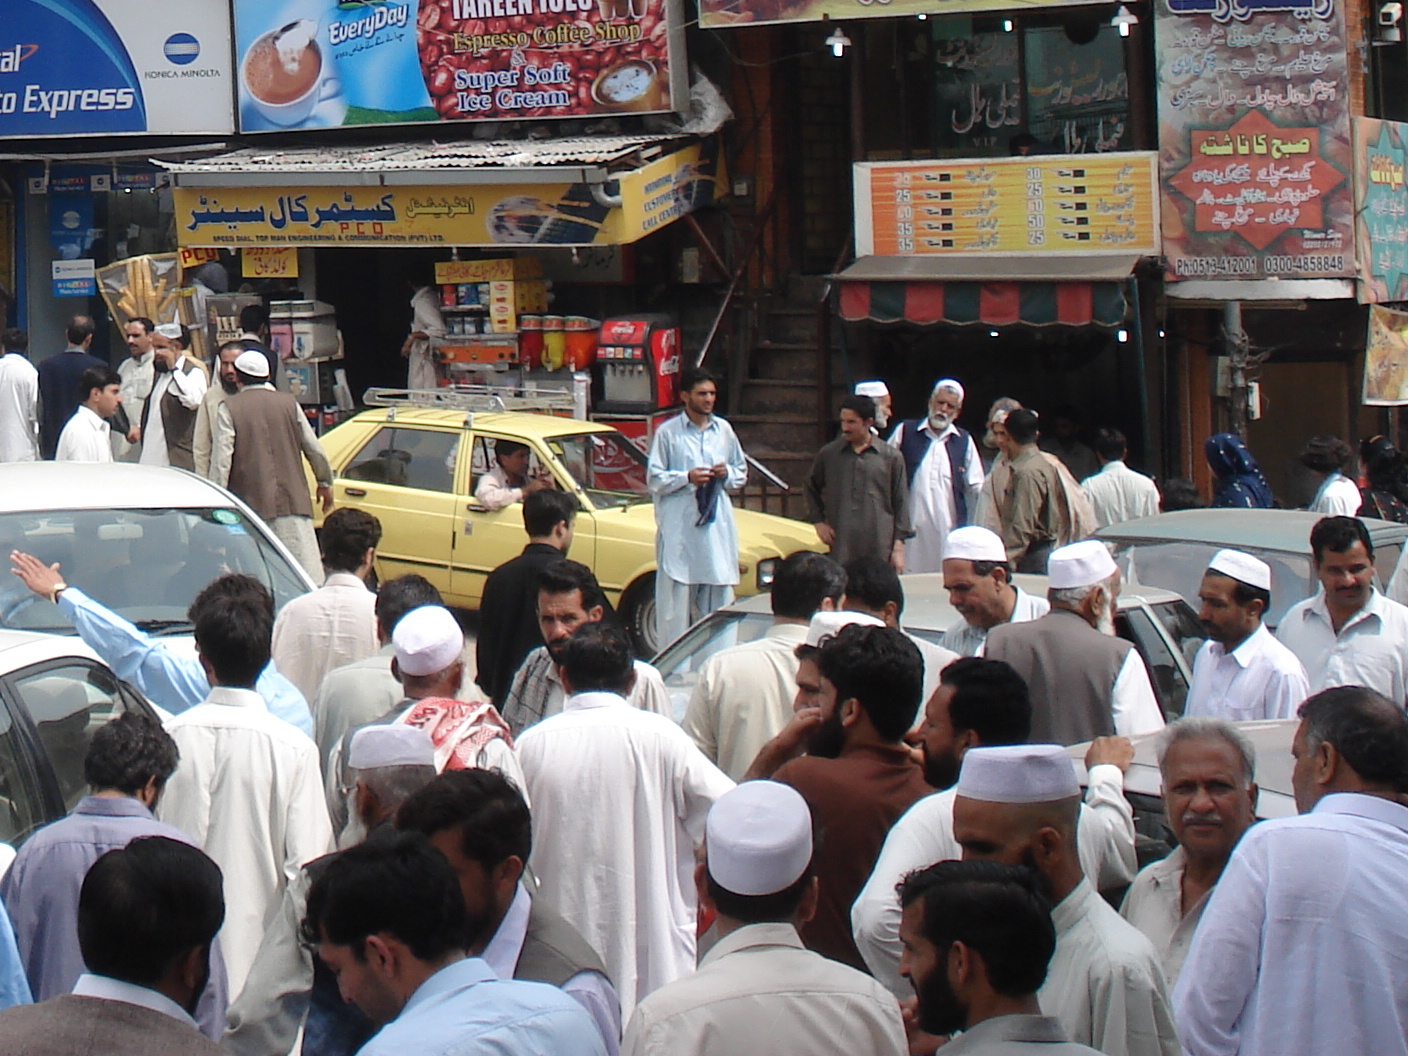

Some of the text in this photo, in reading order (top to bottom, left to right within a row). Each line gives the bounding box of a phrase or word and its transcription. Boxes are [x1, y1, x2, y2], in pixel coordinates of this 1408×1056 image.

[328, 3, 408, 45] EveryDay
[453, 22, 641, 57] Espresso Coffee Shop
[144, 68, 222, 80] KONICA MINOLTA
[455, 65, 571, 92] Super Soft
[23, 84, 137, 119] Express
[457, 87, 571, 112] Ice Cream
[1253, 134, 1269, 155] کا
[1269, 137, 1310, 159] صبح
[895, 189, 912, 204] 25
[1027, 182, 1042, 196] 25
[186, 191, 475, 231] انٹرنیشنل کسٹمر کال سینٹر
[1028, 214, 1044, 228] 50
[898, 222, 913, 236] 35
[1028, 230, 1044, 245] 25
[898, 238, 914, 251] 35
